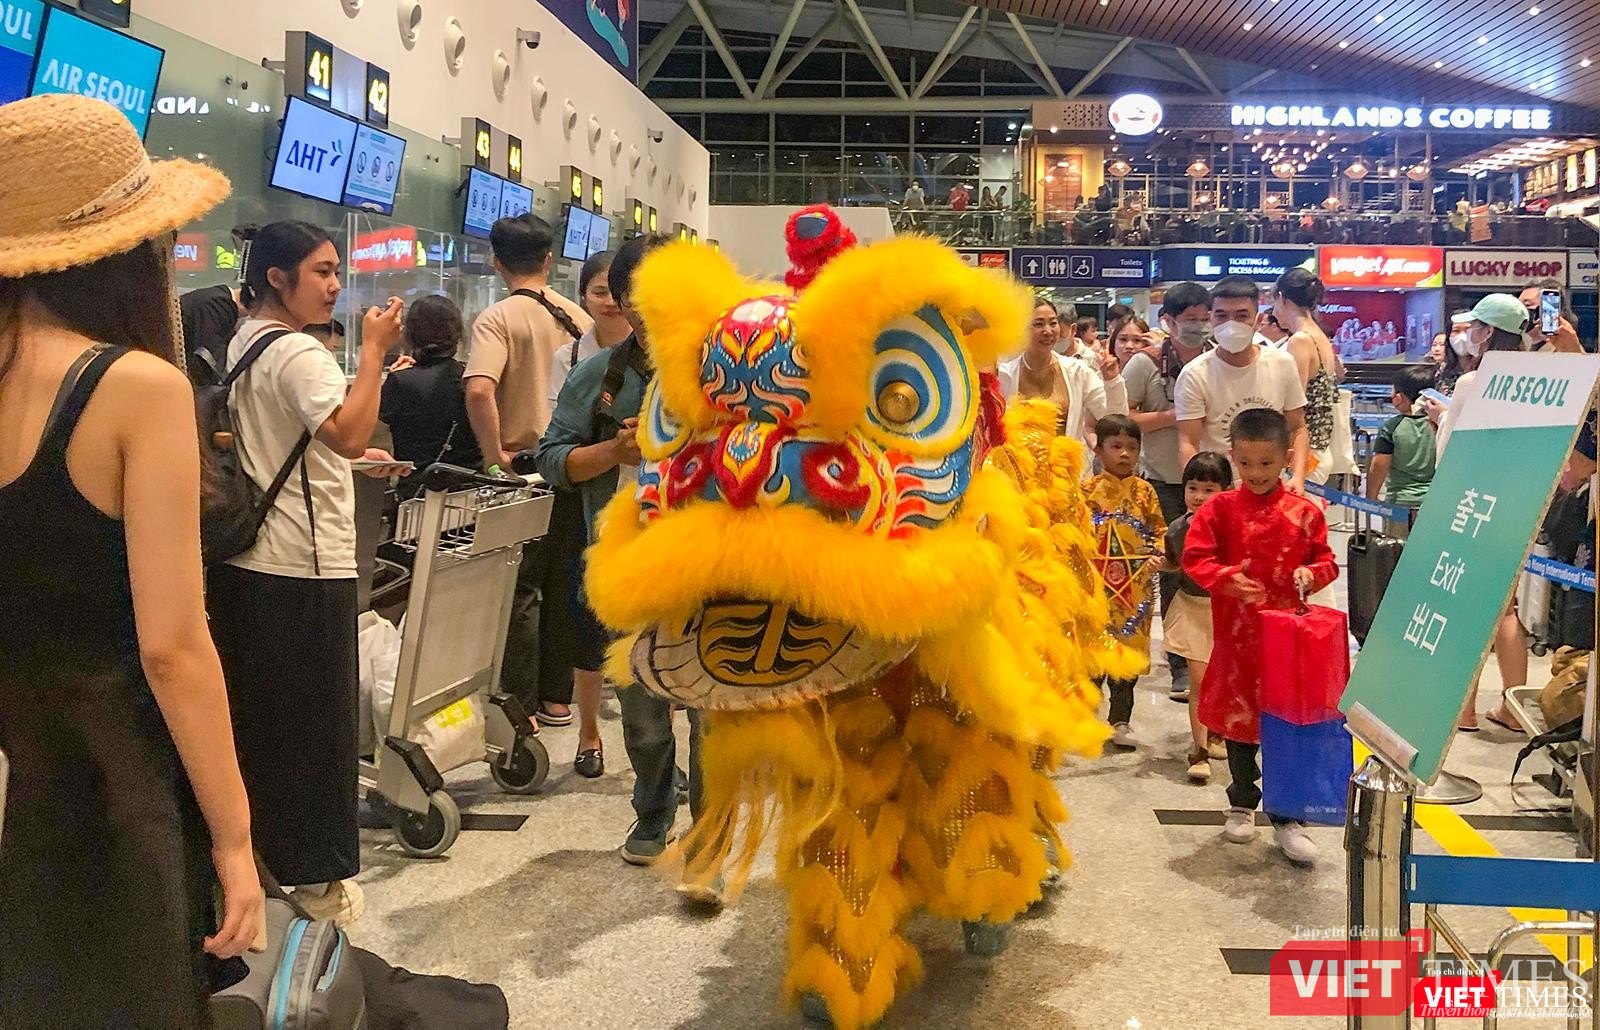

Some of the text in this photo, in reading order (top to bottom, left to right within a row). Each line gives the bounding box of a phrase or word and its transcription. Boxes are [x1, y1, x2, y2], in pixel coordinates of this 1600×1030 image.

[0, 2, 33, 41] UL
[42, 58, 146, 114] AIR SEOUL
[308, 50, 330, 90] 41
[368, 79, 387, 115] 42
[1231, 105, 1552, 130] HIGHLANDS COFFEE
[285, 139, 329, 174] AHT
[476, 131, 490, 159] 43
[509, 146, 521, 173] 44
[1228, 258, 1262, 266] TICKETING
[1228, 266, 1286, 275] EXCESS BAGGAGE
[1451, 260, 1563, 277] LUCKY SHOP
[1482, 374, 1570, 407] AIR SEOUL
[1451, 488, 1497, 538] 출구
[1430, 551, 1466, 594] Exit
[1403, 602, 1448, 655] 出口
